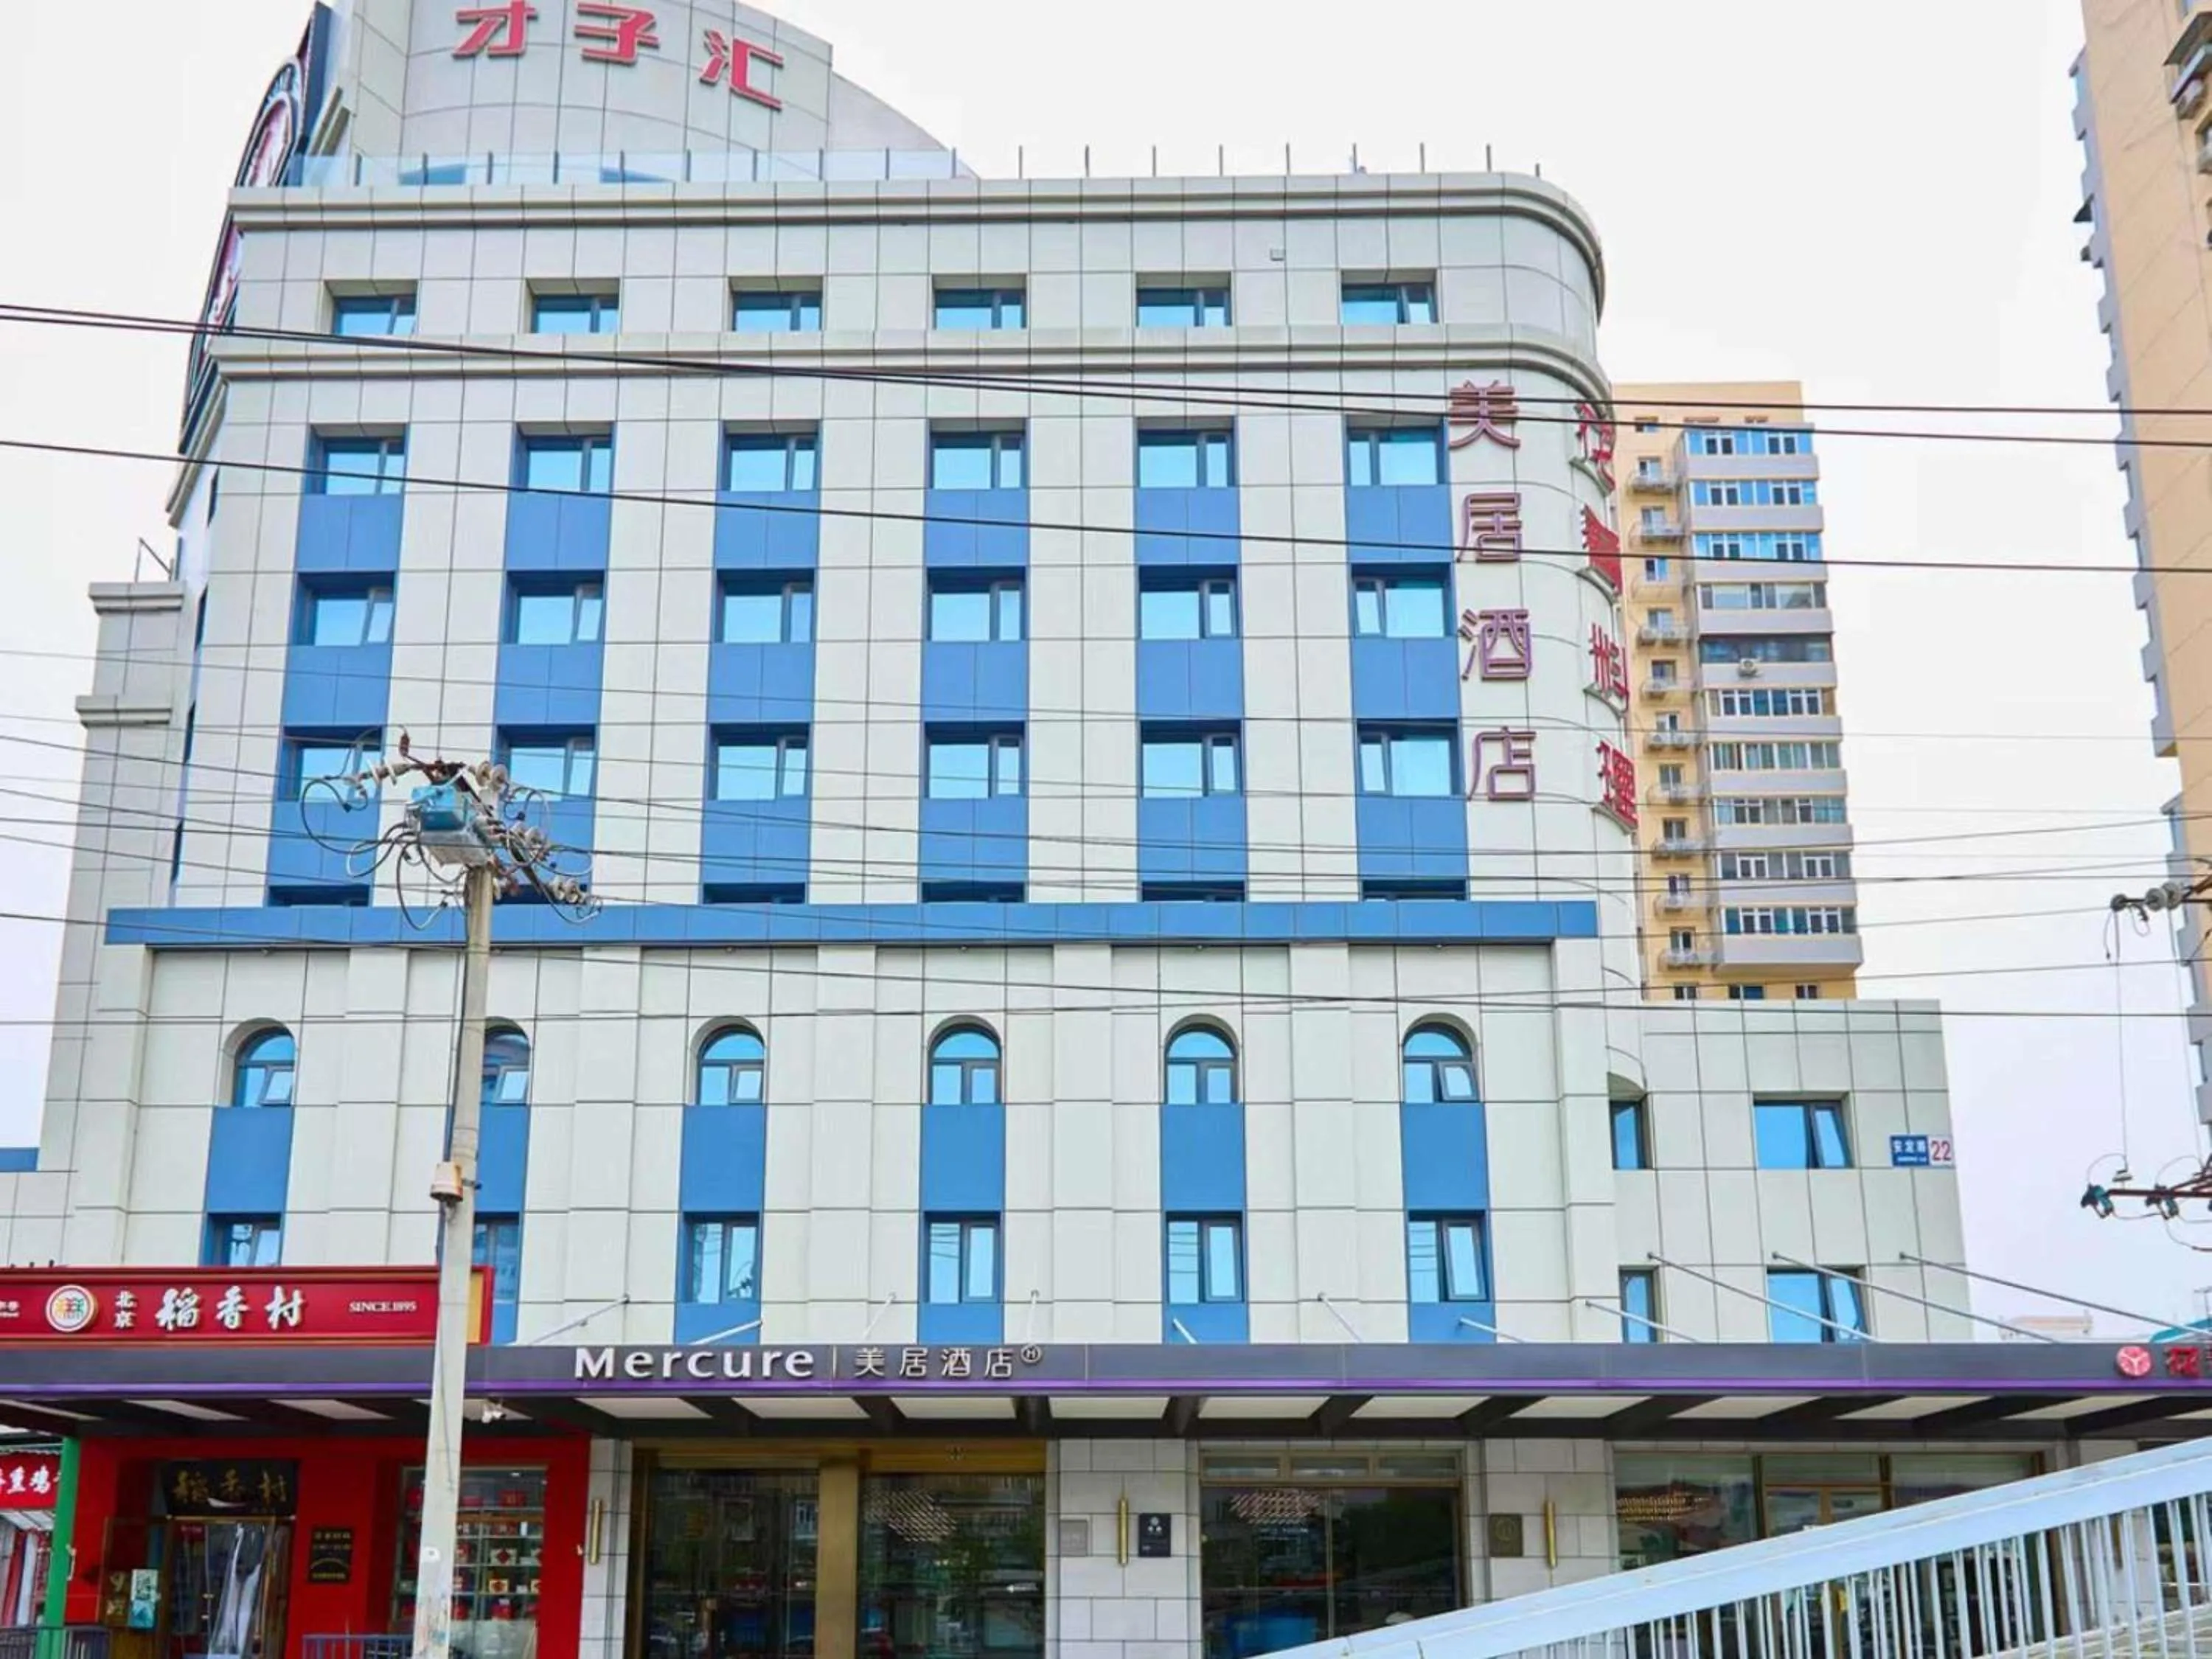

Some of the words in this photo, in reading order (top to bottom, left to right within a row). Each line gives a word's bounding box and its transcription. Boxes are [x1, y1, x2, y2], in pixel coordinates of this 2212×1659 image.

[452, 0, 785, 112] 才子汇
[1447, 379, 1537, 801] 美居酒店
[1931, 1140, 1951, 1161] 22
[115, 1290, 138, 1328] 北京
[155, 1285, 304, 1330] 稻香村
[574, 1347, 814, 1379] Mercure
[854, 1346, 1015, 1377] 美居酒店
